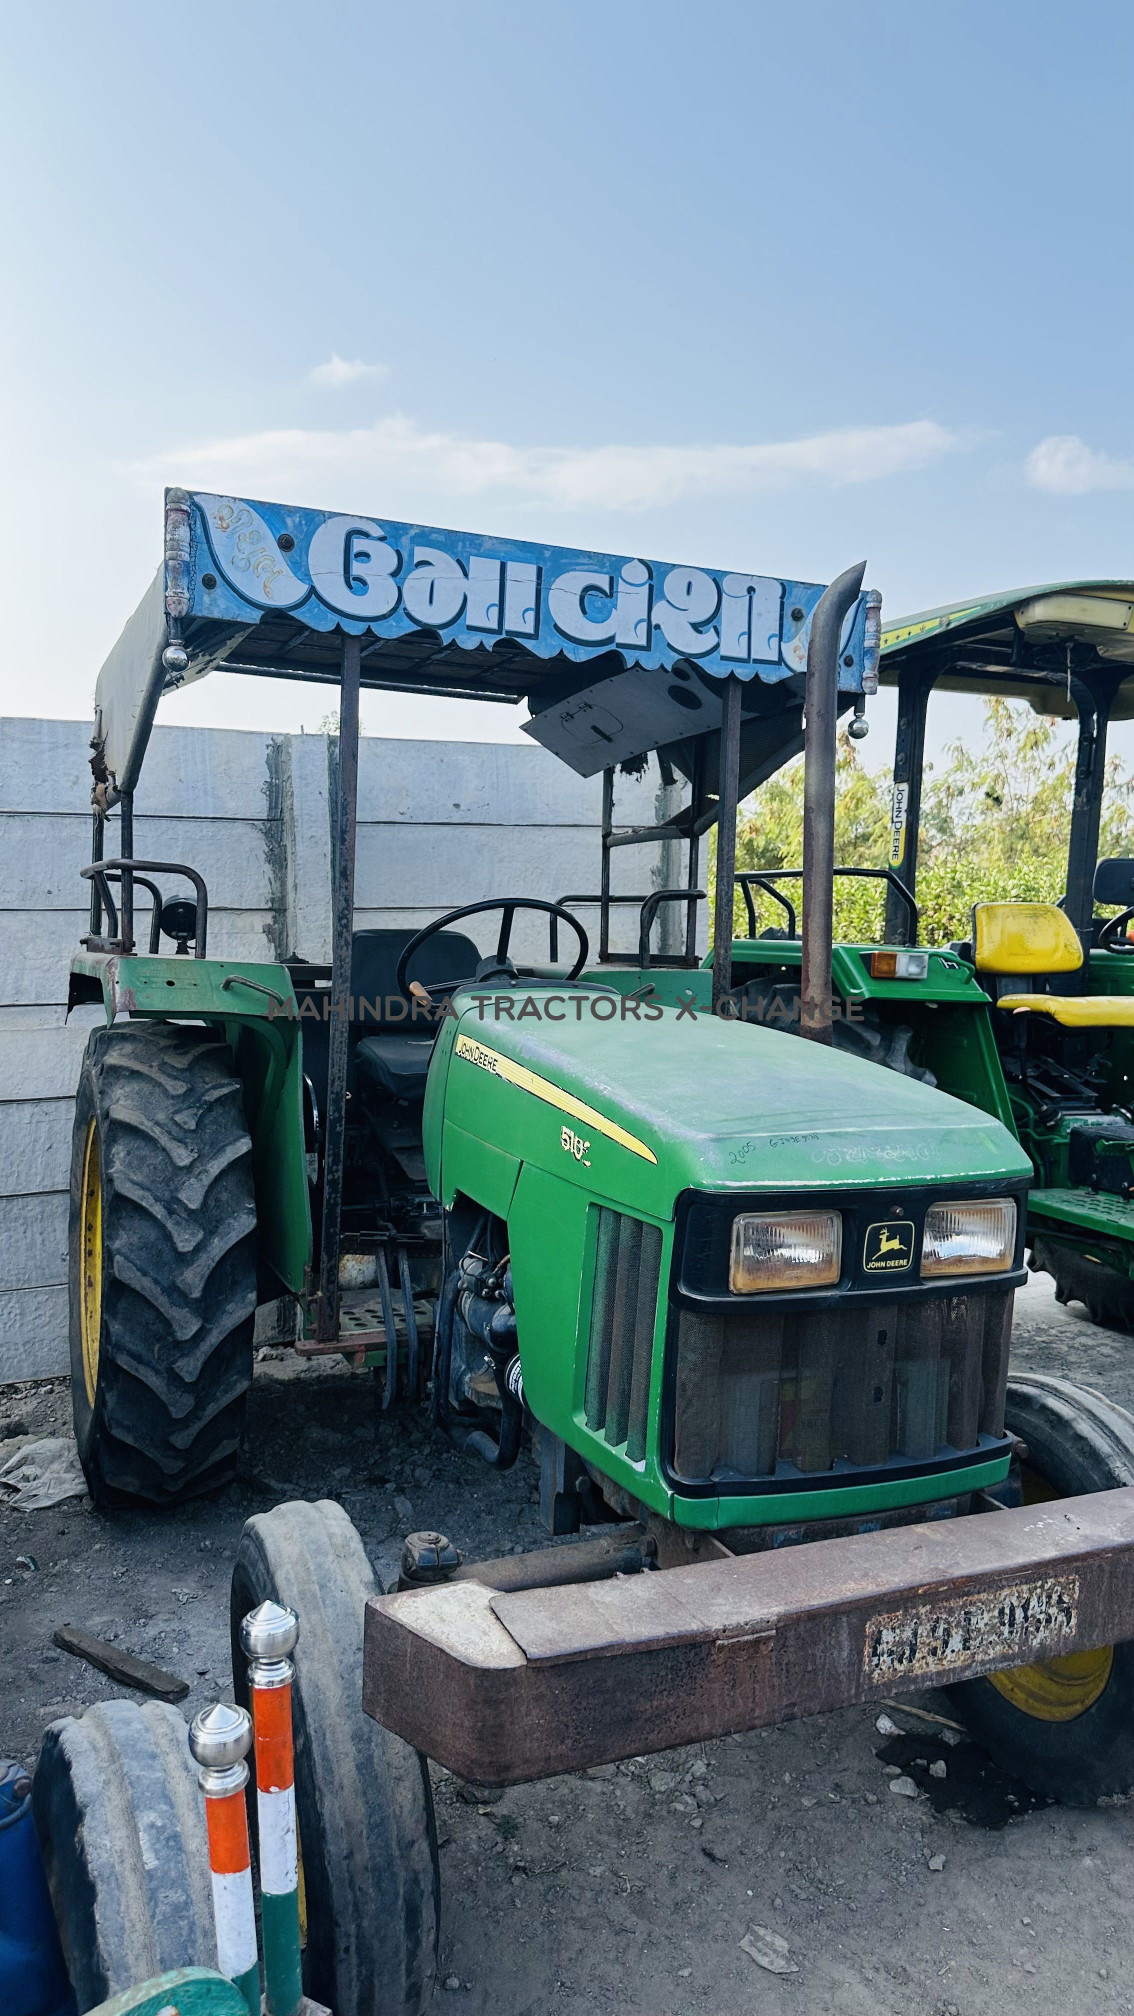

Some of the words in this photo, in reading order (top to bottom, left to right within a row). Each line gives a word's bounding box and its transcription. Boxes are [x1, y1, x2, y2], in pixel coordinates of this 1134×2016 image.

[308, 515, 786, 666] ઉમાવંશી
[895, 788, 905, 818] JOHN
[892, 820, 902, 860] DEERE
[728, 1140, 757, 1165] 2005
[866, 1260, 886, 1269] JOHN
[886, 1258, 908, 1267] DEERE
